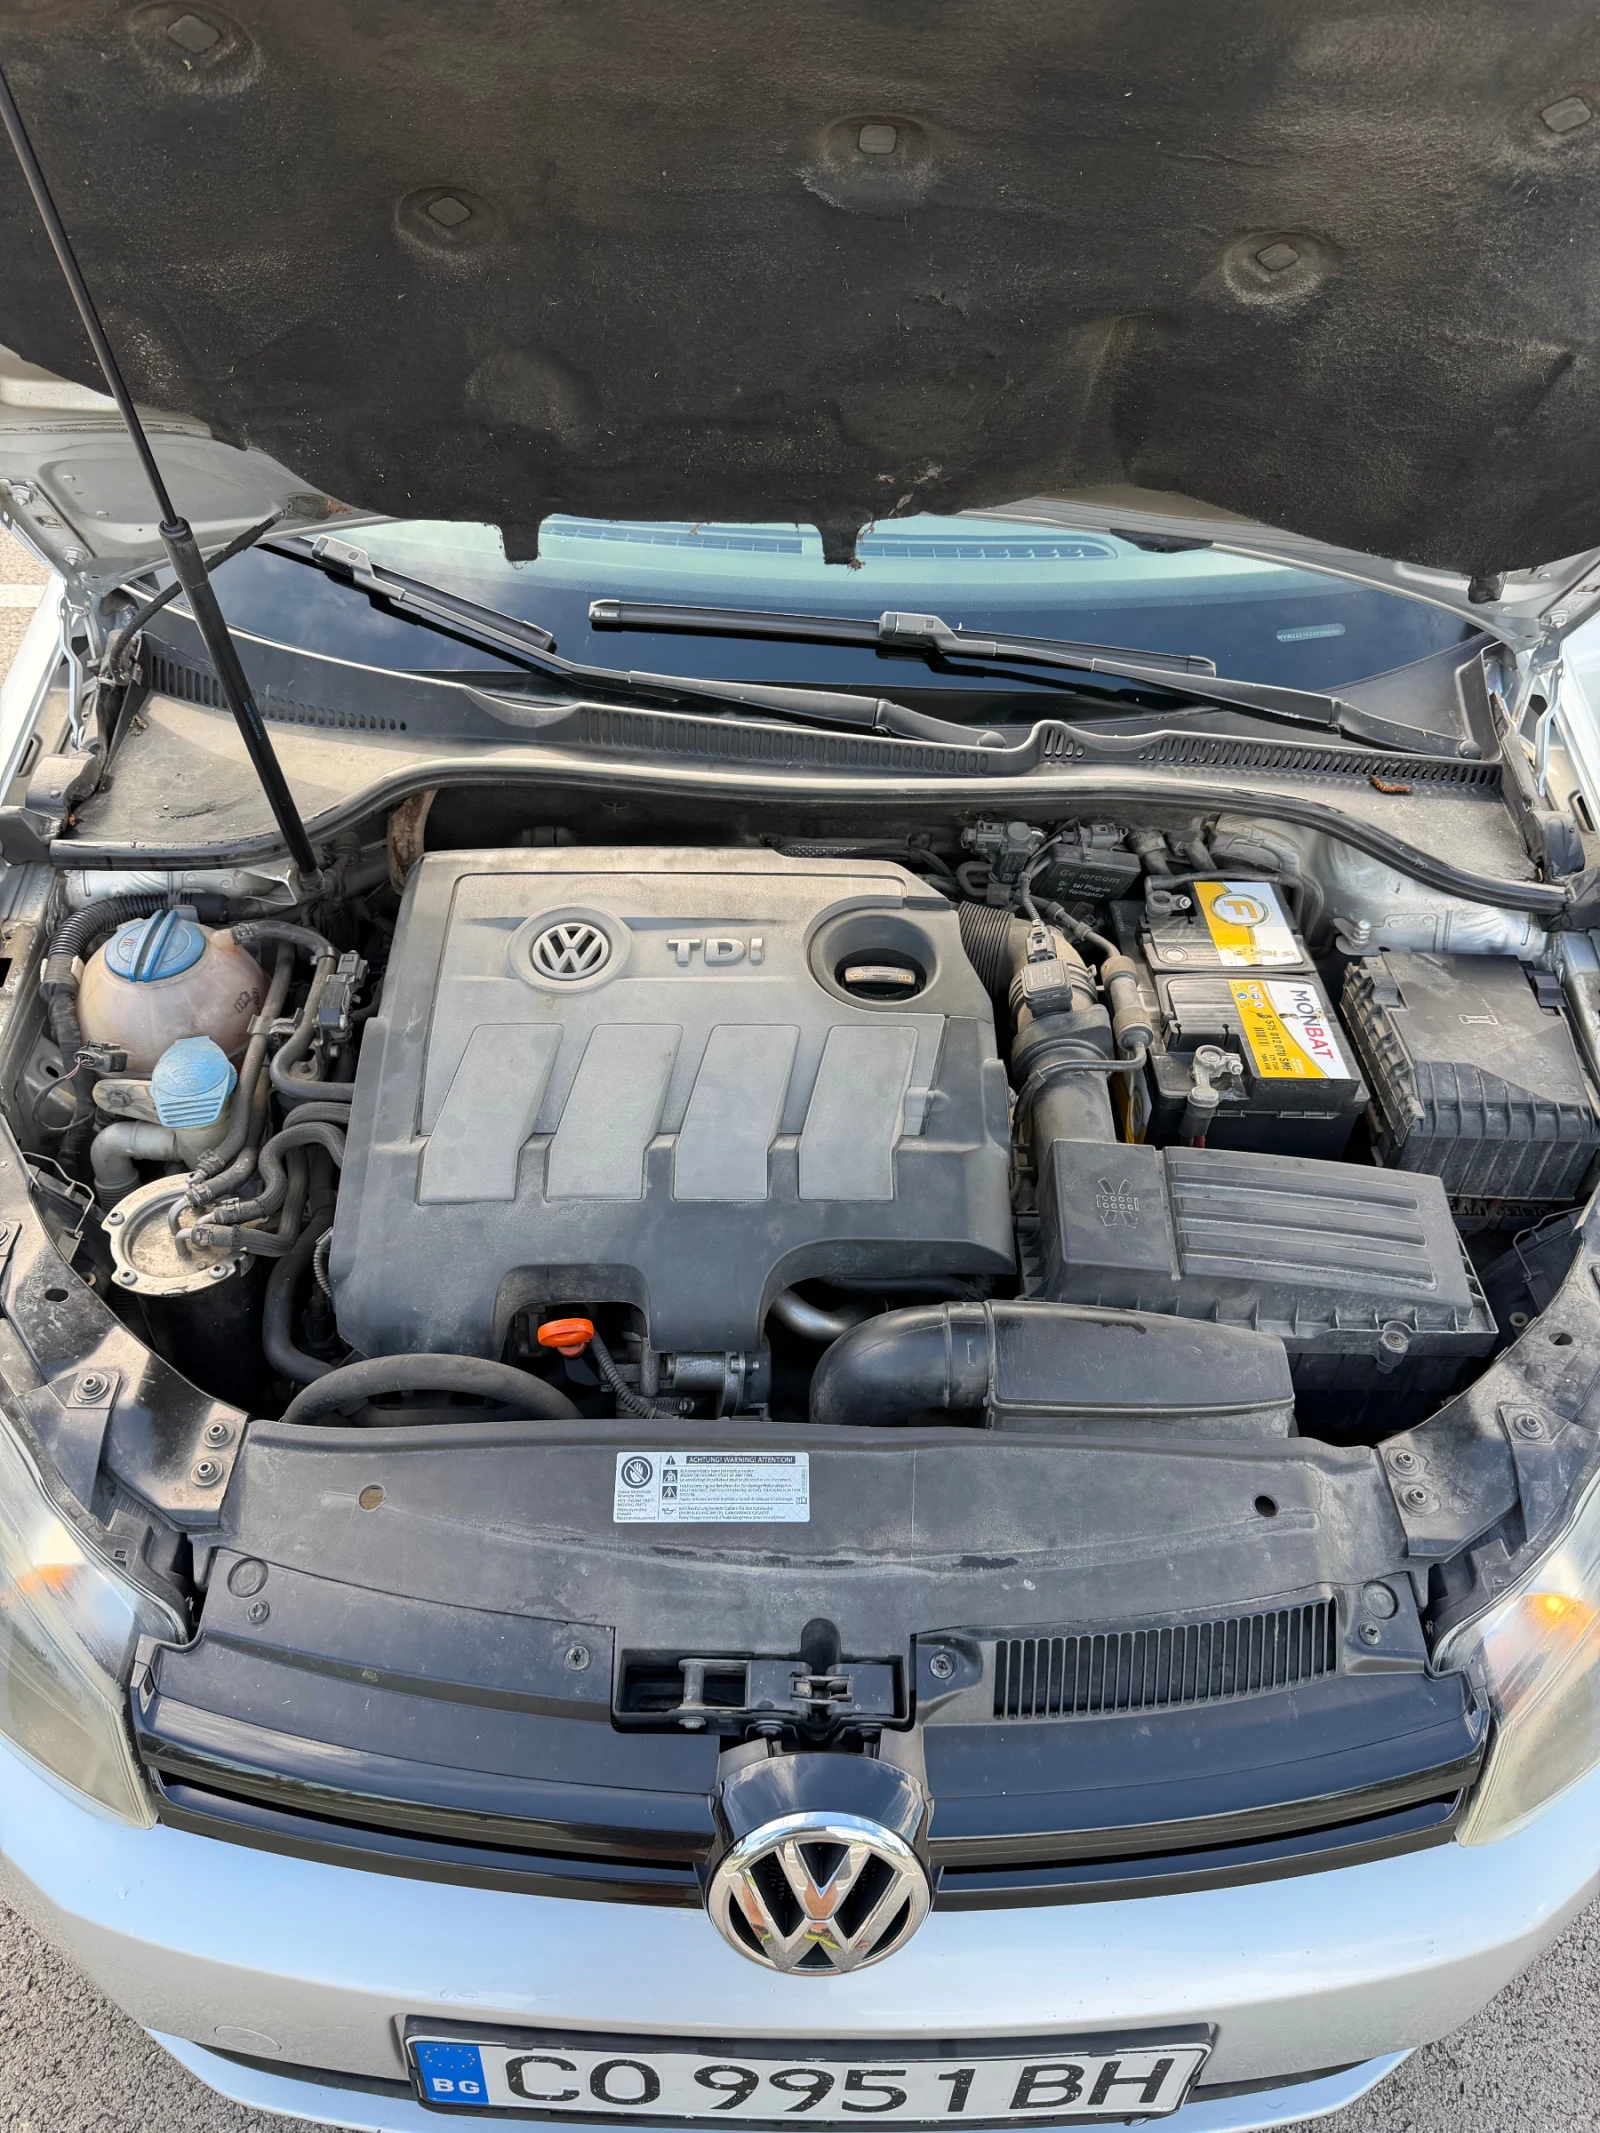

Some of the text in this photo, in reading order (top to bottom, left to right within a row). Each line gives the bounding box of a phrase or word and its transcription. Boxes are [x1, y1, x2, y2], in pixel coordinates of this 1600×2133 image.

[1058, 880, 1111, 893] Dital Plug-in
[1060, 868, 1121, 885] Geercom
[1057, 887, 1105, 899] Pformance
[666, 937, 766, 967] TDI
[1289, 989, 1334, 1060] MONBAT
[1265, 1020, 1293, 1071] 575 012 070 SMF
[689, 1456, 793, 1464] ACHTUNG! WARNING! ATTENTION!
[707, 1811, 932, 1976] VW
[431, 2076, 481, 2096] BG
[503, 2054, 1175, 2114] CO 9951 BH
